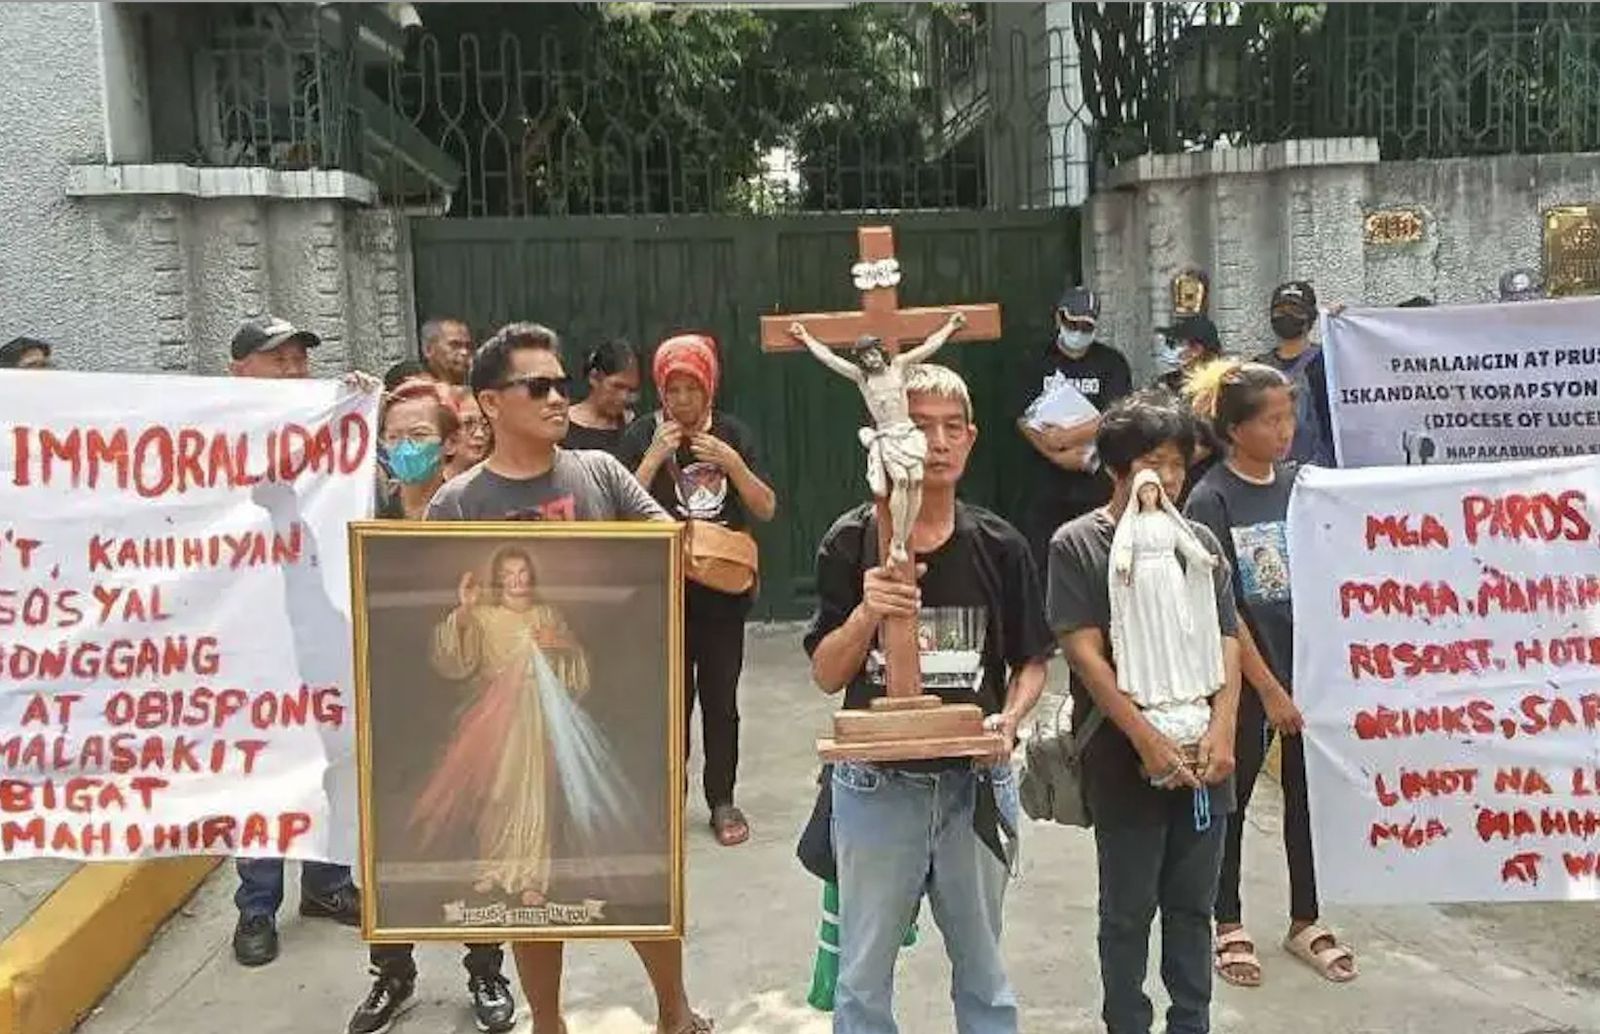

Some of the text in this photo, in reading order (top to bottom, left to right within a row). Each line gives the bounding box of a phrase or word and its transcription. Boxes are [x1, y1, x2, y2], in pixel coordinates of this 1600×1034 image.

[1390, 347, 1600, 374] PANALANGIN AT PRU
[1340, 380, 1597, 405] ISKANDALO'T KORAPSYON
[1425, 411, 1600, 431] (DIOCESE OF LUCE
[12, 411, 370, 498] IMMORALIDAD
[1446, 444, 1560, 459] NAPAKABULOK
[0, 636, 220, 680] ONGGANG
[21, 683, 344, 729] AT OBISPONG
[0, 777, 168, 812] BIGAT
[1494, 767, 1552, 795] NA
[2, 812, 311, 852] MAHIHIRAP
[1370, 819, 1446, 848] MGA
[1502, 853, 1542, 885] AT
